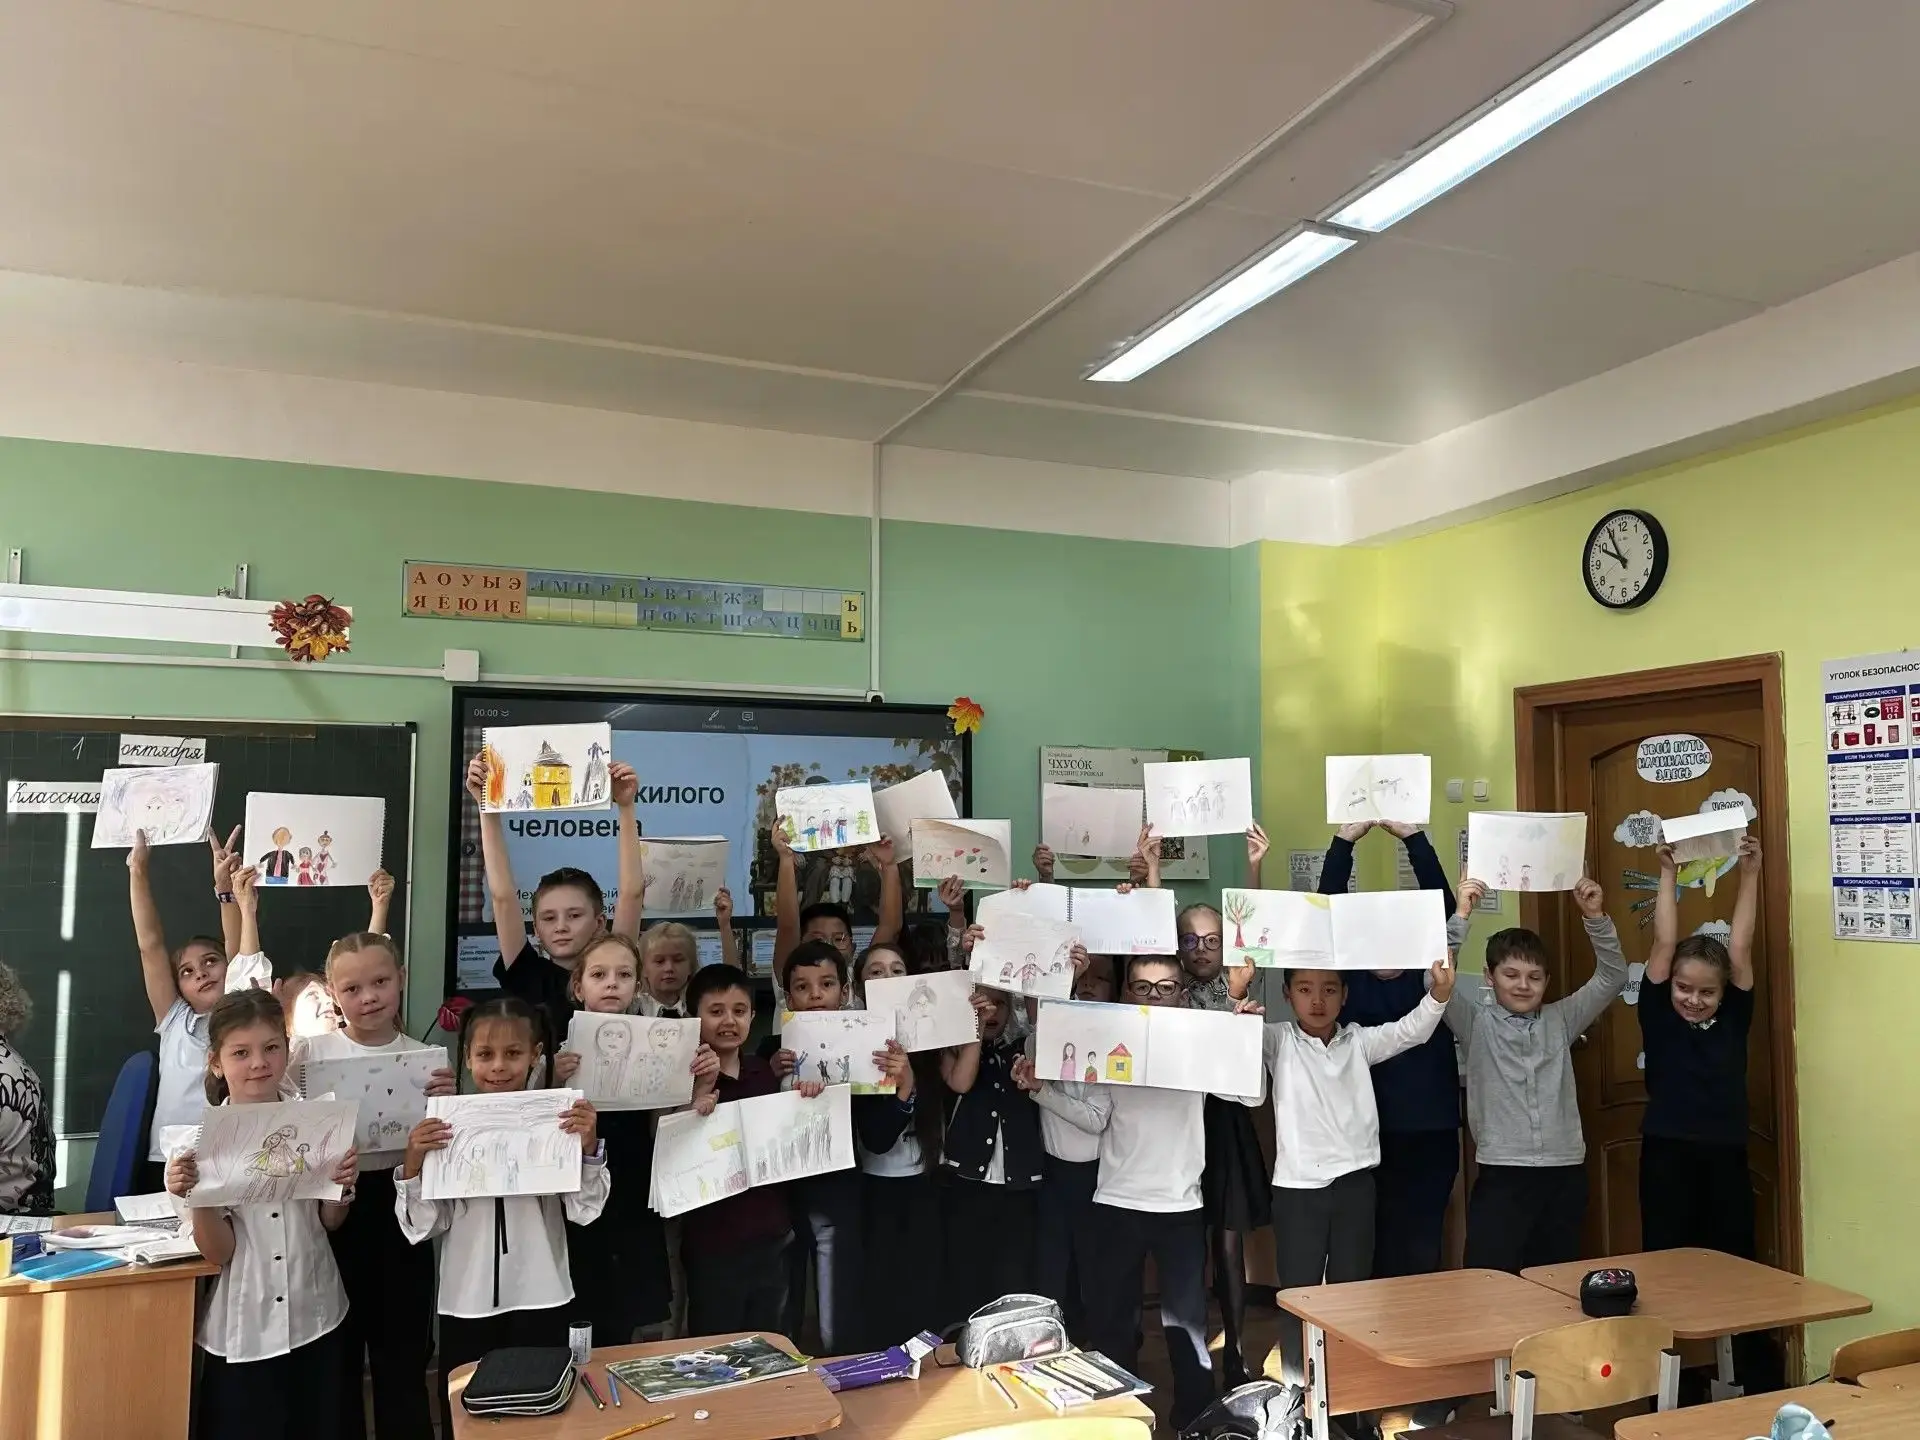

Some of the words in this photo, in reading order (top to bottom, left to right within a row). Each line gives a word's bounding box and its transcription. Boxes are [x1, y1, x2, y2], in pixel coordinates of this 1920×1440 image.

[1619, 521, 1628, 532] 12
[1634, 524, 1638, 533] 1
[1643, 534, 1649, 544] 2
[1598, 543, 1608, 553] 10
[1647, 549, 1653, 560] 3
[1595, 560, 1601, 570] 9
[1643, 568, 1649, 577] 4
[413, 571, 427, 585] А
[437, 572, 452, 586] О
[462, 574, 475, 587] У
[483, 575, 501, 589] Ы
[508, 577, 522, 590] Э
[1600, 576, 1606, 586] 8
[1634, 581, 1640, 591] 5
[1609, 586, 1615, 597] 7
[1621, 588, 1627, 597] 6
[413, 595, 427, 608] Я
[458, 597, 478, 612] Ю
[484, 599, 499, 613] И
[509, 600, 521, 613] Е
[1829, 670, 1860, 680] УГОЛОК
[1862, 663, 1920, 677] БЕЗОПАСНОС
[1832, 692, 1859, 700] ПОЖАРНАЯ
[1859, 688, 1898, 697] БЕЗОПАСНОСТЬ
[72, 736, 85, 760] 1
[120, 736, 204, 766] октября
[1641, 740, 1671, 756] ТВОЙ
[1673, 739, 1704, 753] ПУТЬ
[1638, 752, 1711, 769] НАЧИНАЕТСЯ
[1656, 767, 1693, 781] ЗДЕСЬ
[9, 782, 101, 804] Классная
[634, 785, 725, 804] жилого
